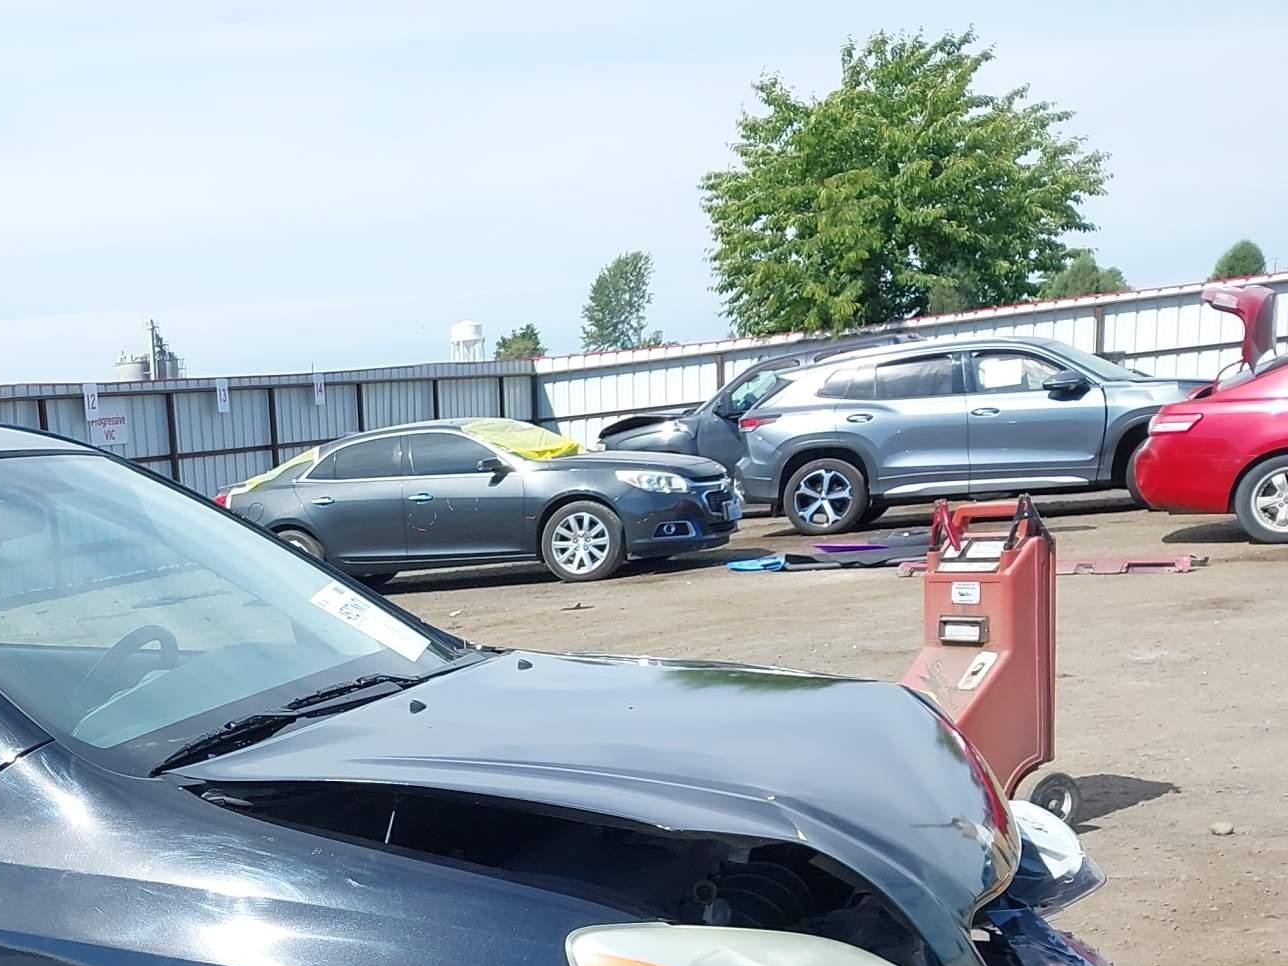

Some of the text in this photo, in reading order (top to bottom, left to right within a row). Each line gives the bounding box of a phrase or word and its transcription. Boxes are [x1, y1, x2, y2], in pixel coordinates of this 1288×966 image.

[86, 393, 97, 410] 12
[218, 388, 227, 403] 13
[103, 429, 116, 441] VIC
